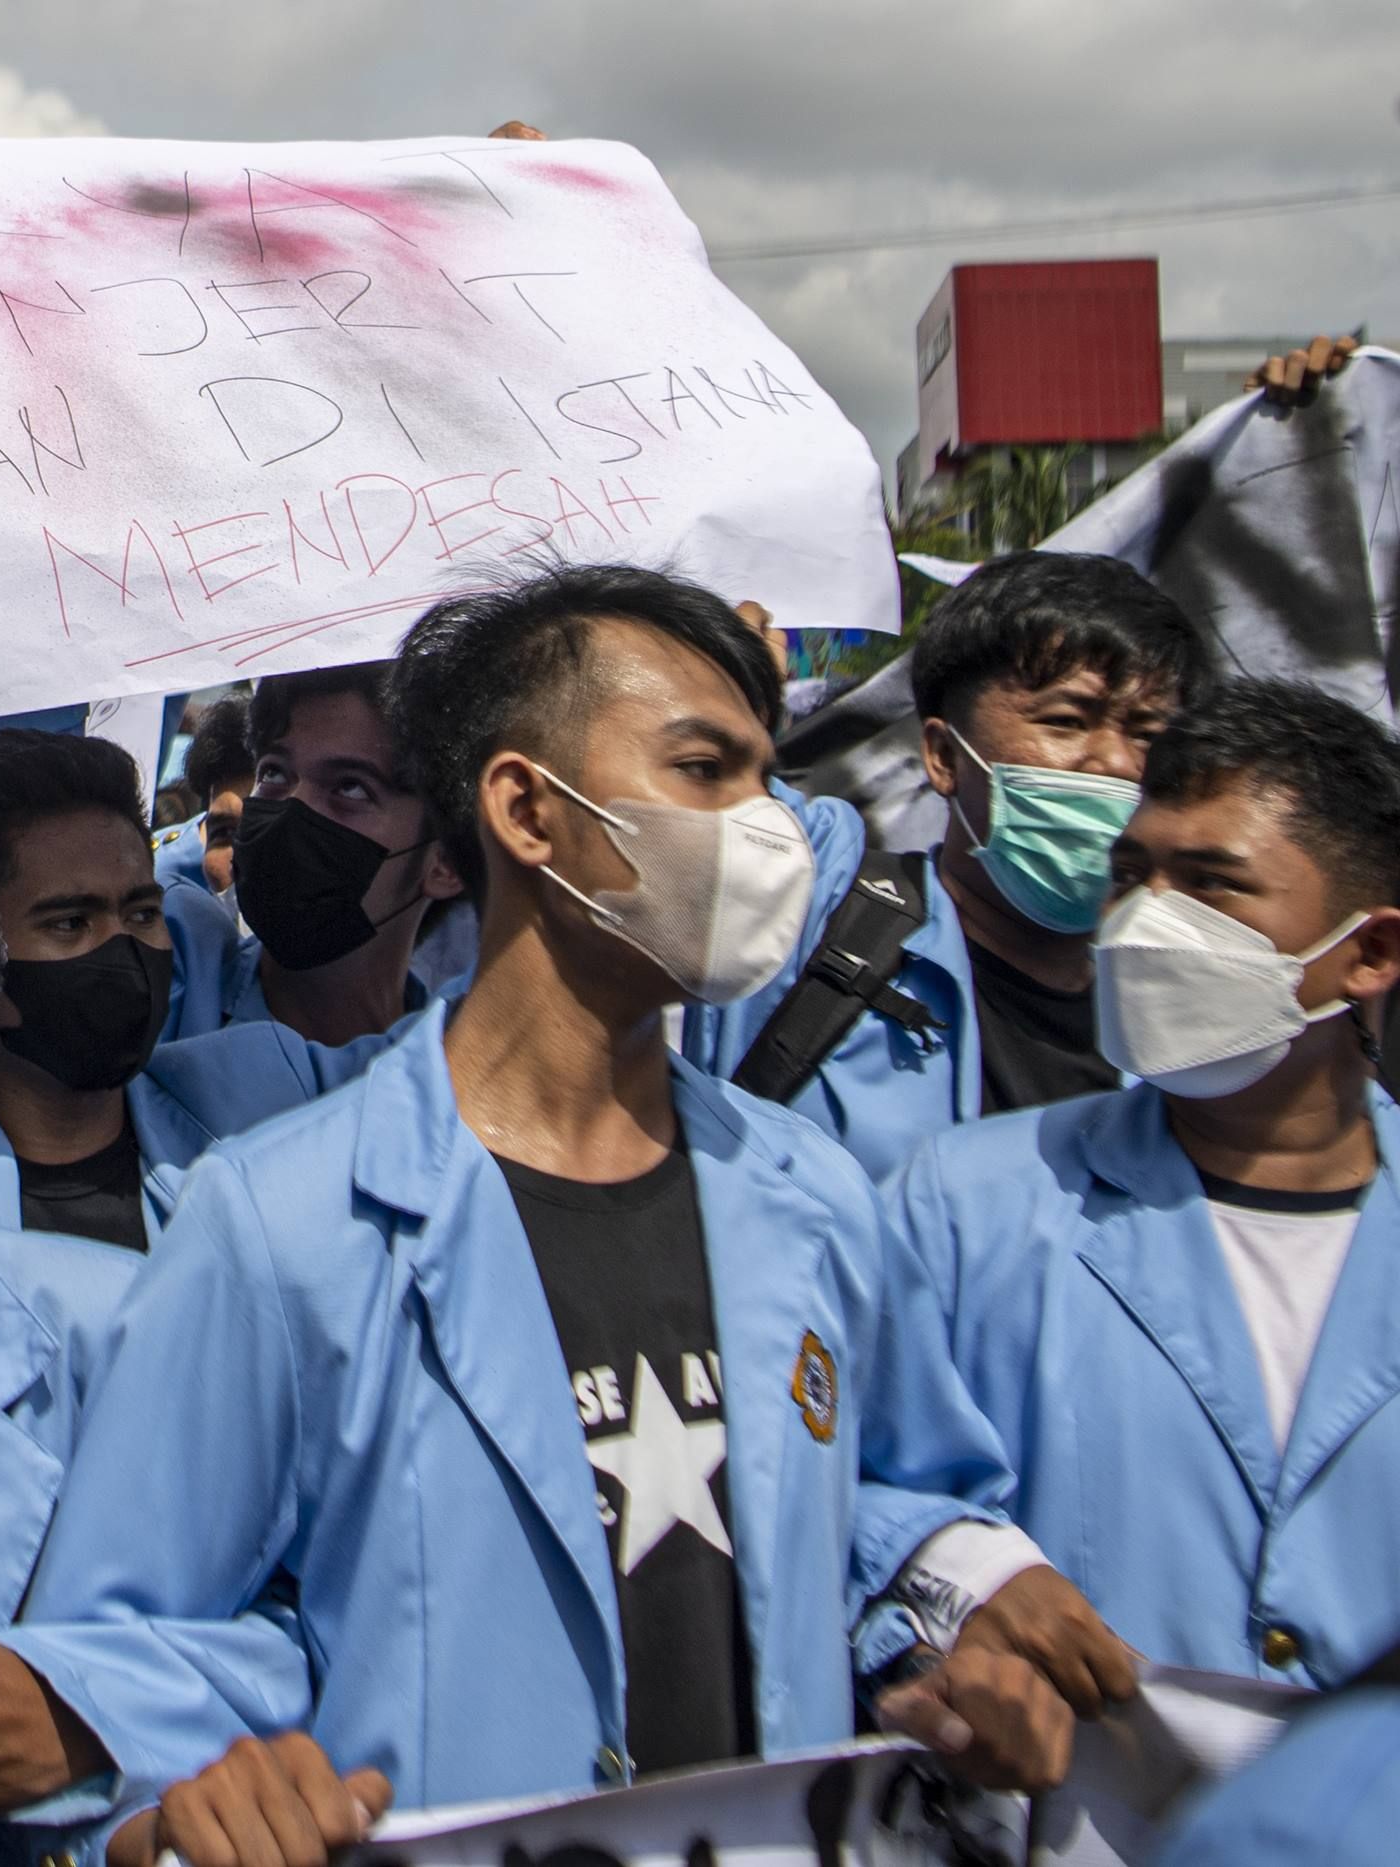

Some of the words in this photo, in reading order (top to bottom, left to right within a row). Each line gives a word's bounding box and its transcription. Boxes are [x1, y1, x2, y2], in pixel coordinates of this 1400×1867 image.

[199, 376, 426, 467] DI
[495, 359, 814, 464] ISTANA
[43, 468, 660, 638] MENDESAH
